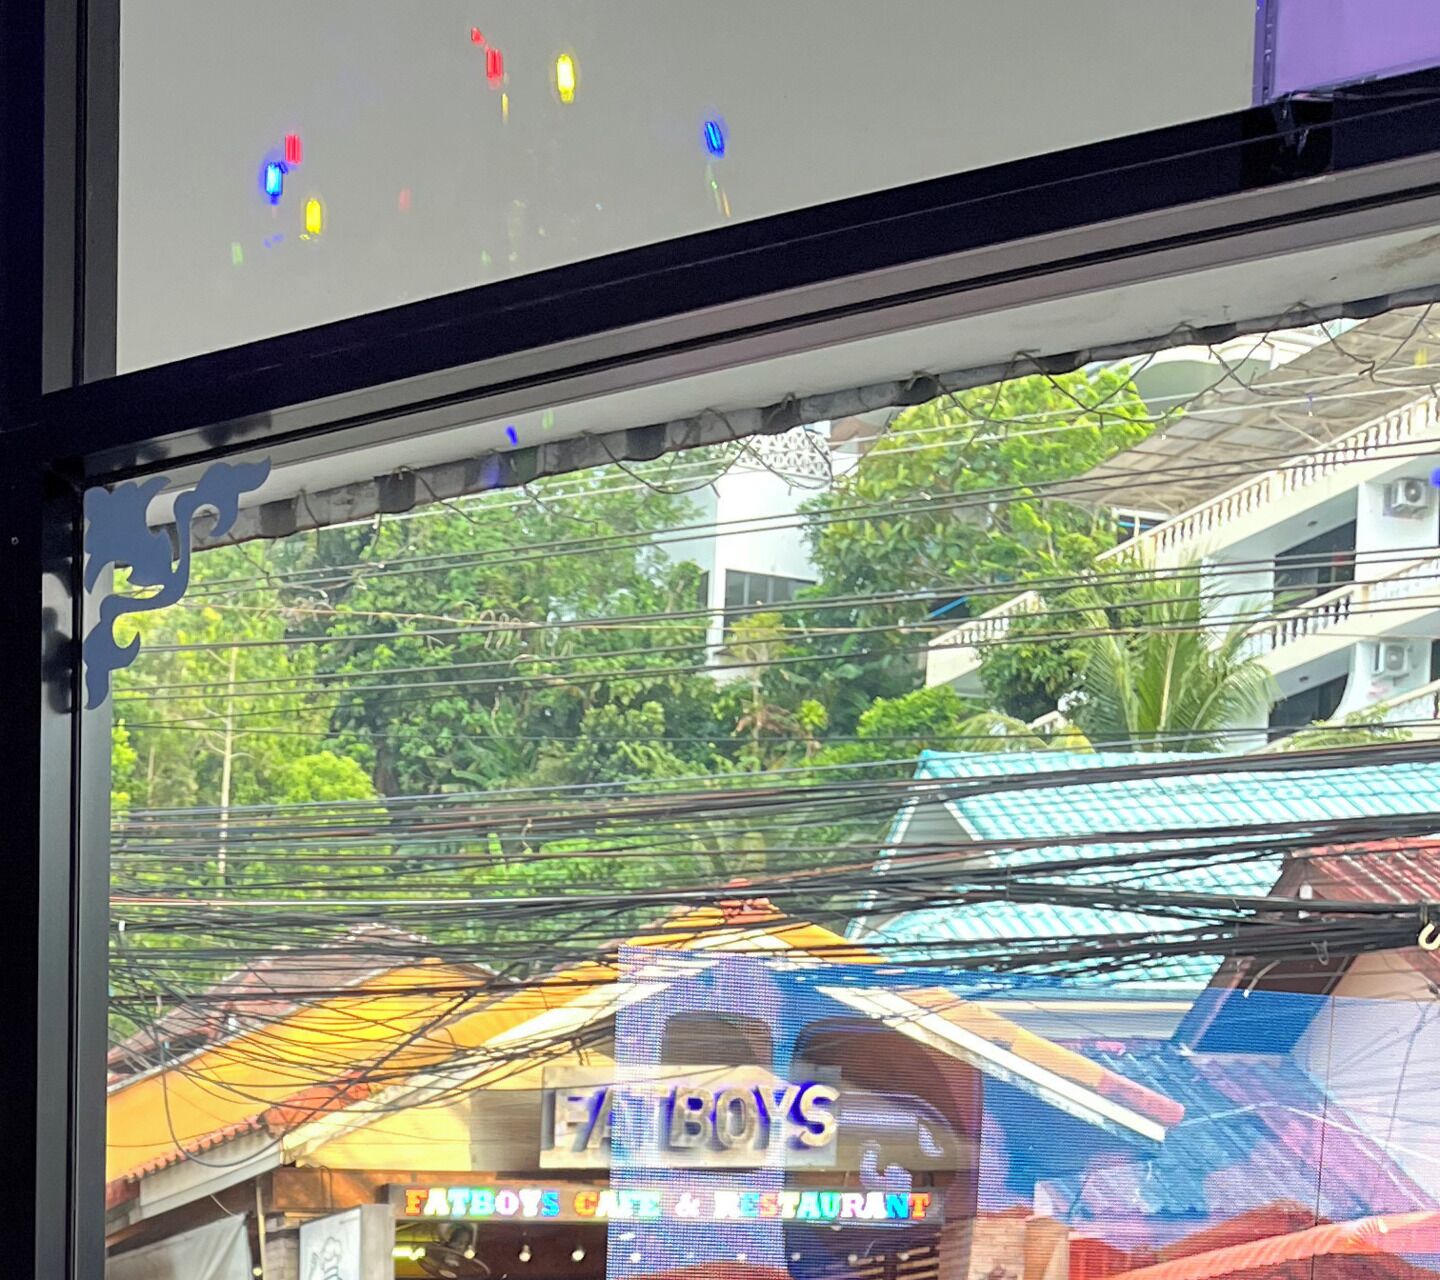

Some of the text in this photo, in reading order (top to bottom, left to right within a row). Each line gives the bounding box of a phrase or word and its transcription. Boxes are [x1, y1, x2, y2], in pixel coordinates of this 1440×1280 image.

[545, 1083, 841, 1150] FATBOYS
[405, 1187, 933, 1221] FATBOYS CAFE & RESTAURANT
